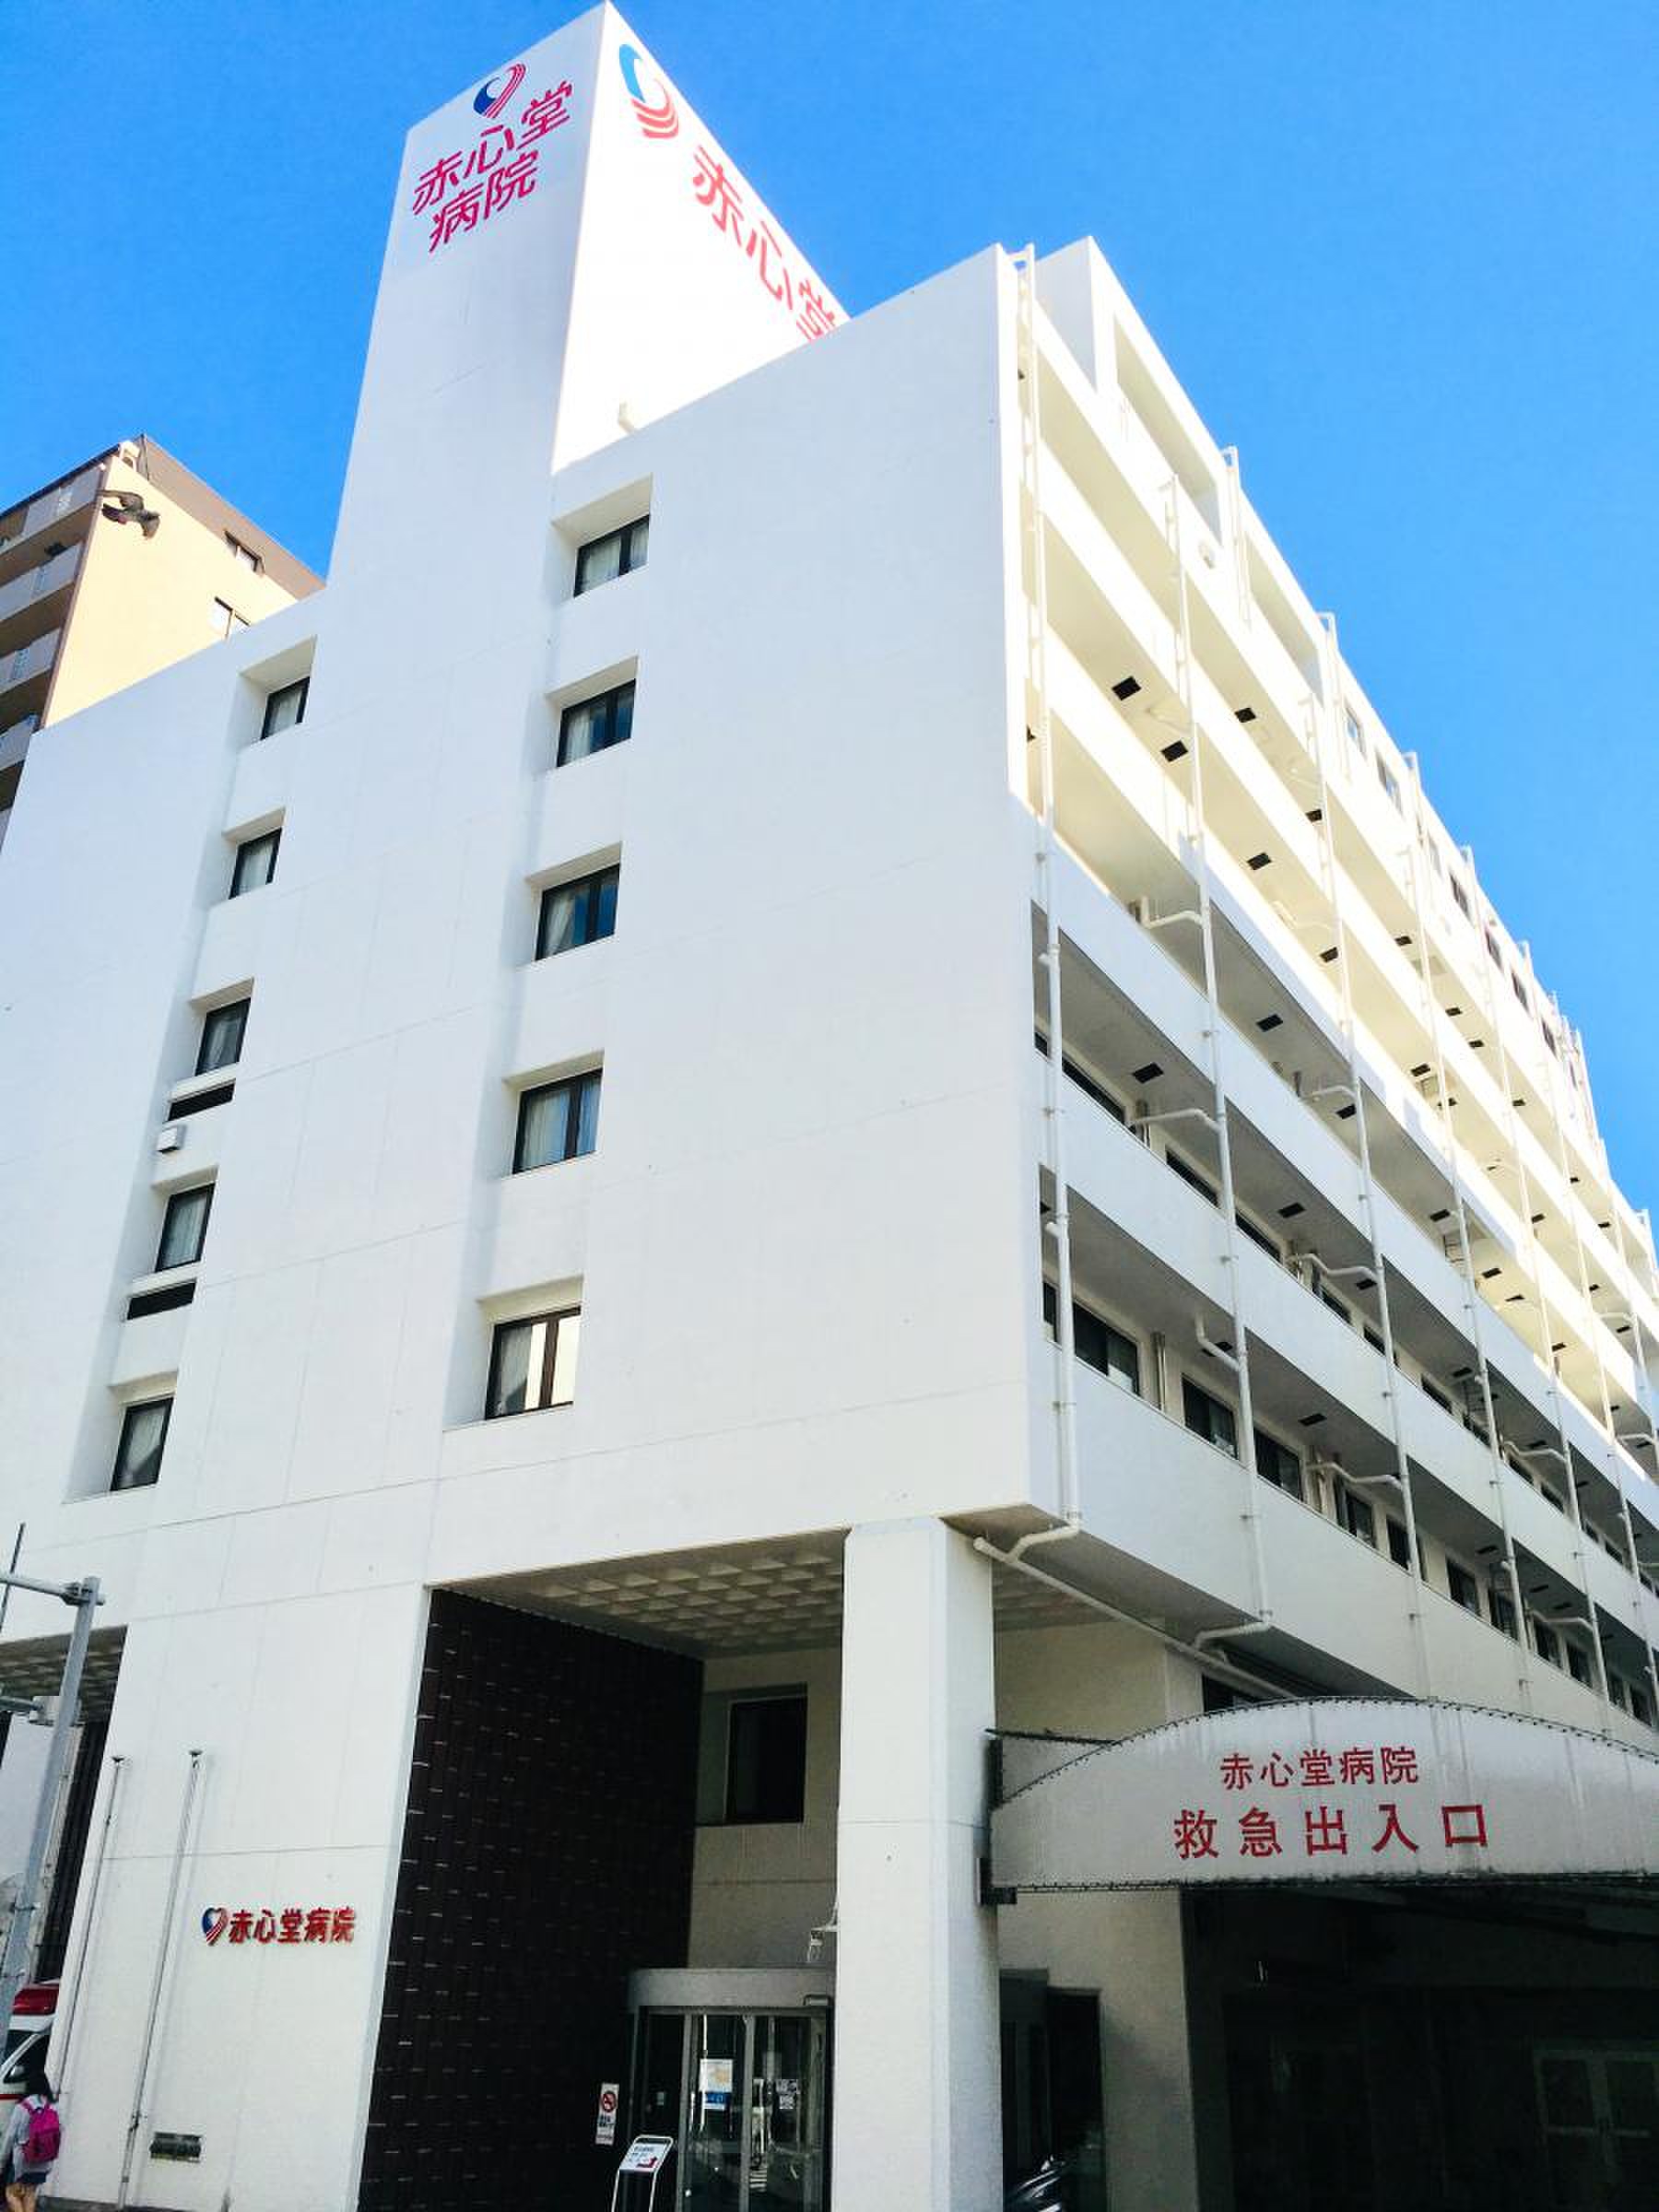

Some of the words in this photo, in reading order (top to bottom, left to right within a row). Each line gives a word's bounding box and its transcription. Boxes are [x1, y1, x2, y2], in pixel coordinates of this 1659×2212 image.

[412, 79, 573, 216] 赤心堂
[428, 149, 538, 253] 病院
[1219, 1746, 1419, 1791] 赤心堂病院
[1173, 1804, 1488, 1859] 救急出入口
[228, 1905, 356, 1945] 赤心堂病院
